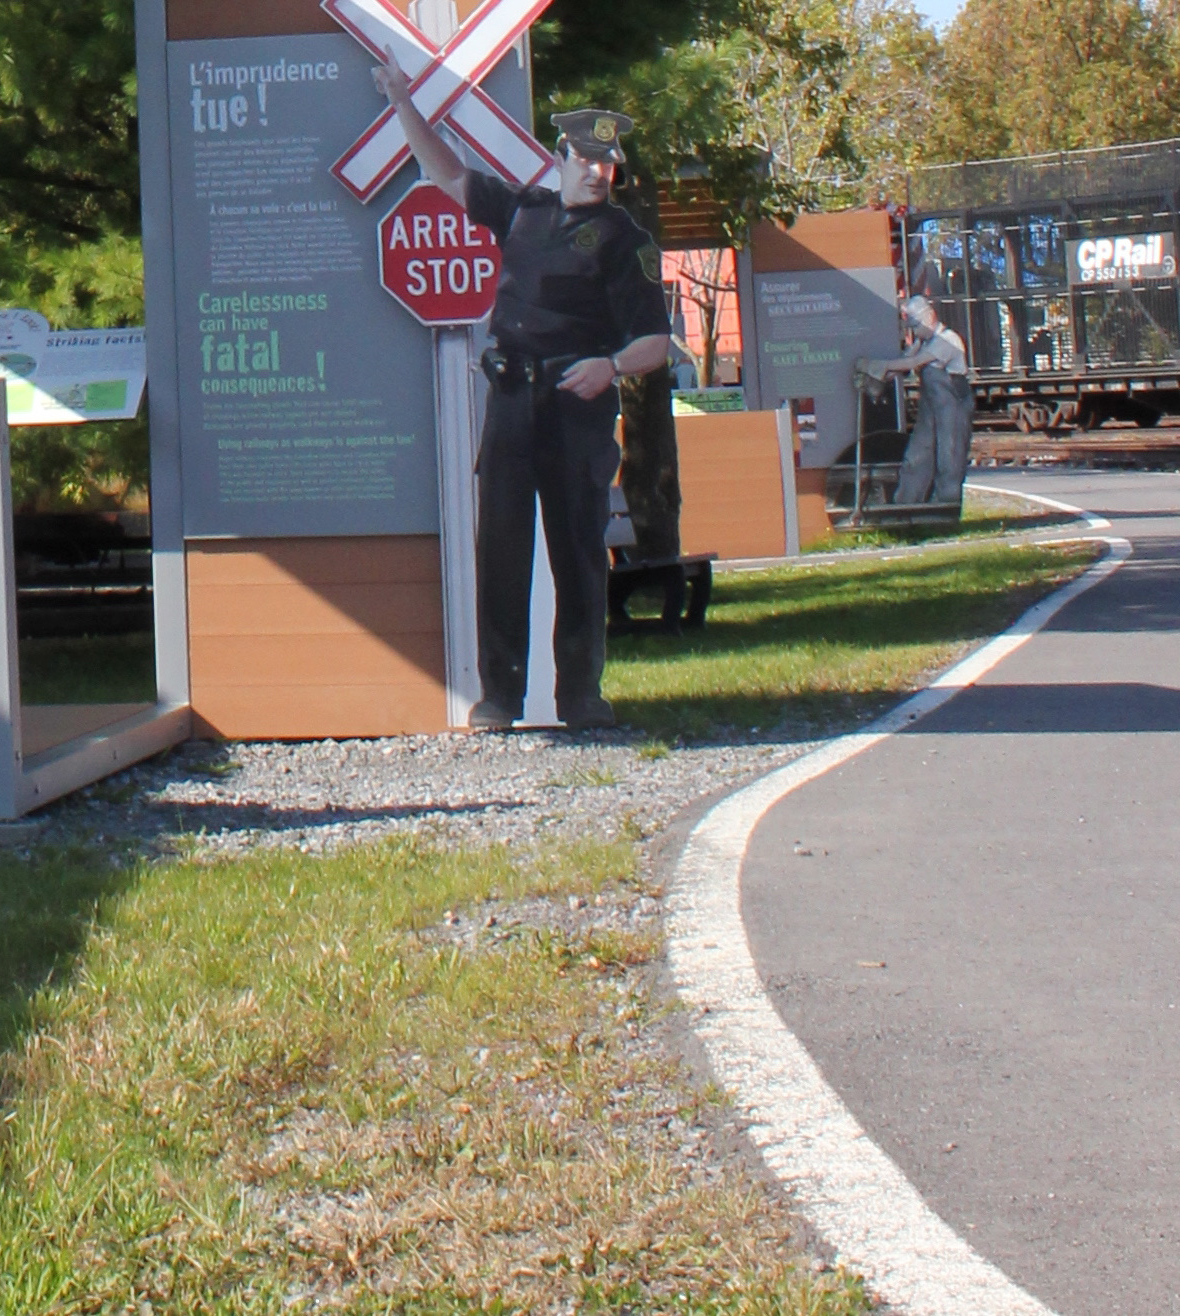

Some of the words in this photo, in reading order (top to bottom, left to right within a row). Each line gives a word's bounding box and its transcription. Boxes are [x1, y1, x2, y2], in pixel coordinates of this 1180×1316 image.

[189, 57, 339, 90] L'imprudence
[1077, 239, 1113, 269] CP
[1113, 234, 1163, 267] Rail
[406, 257, 495, 296] STOP
[198, 290, 328, 314] Carelessness
[199, 318, 226, 333] can
[232, 313, 268, 331] have
[200, 330, 280, 373] fatal
